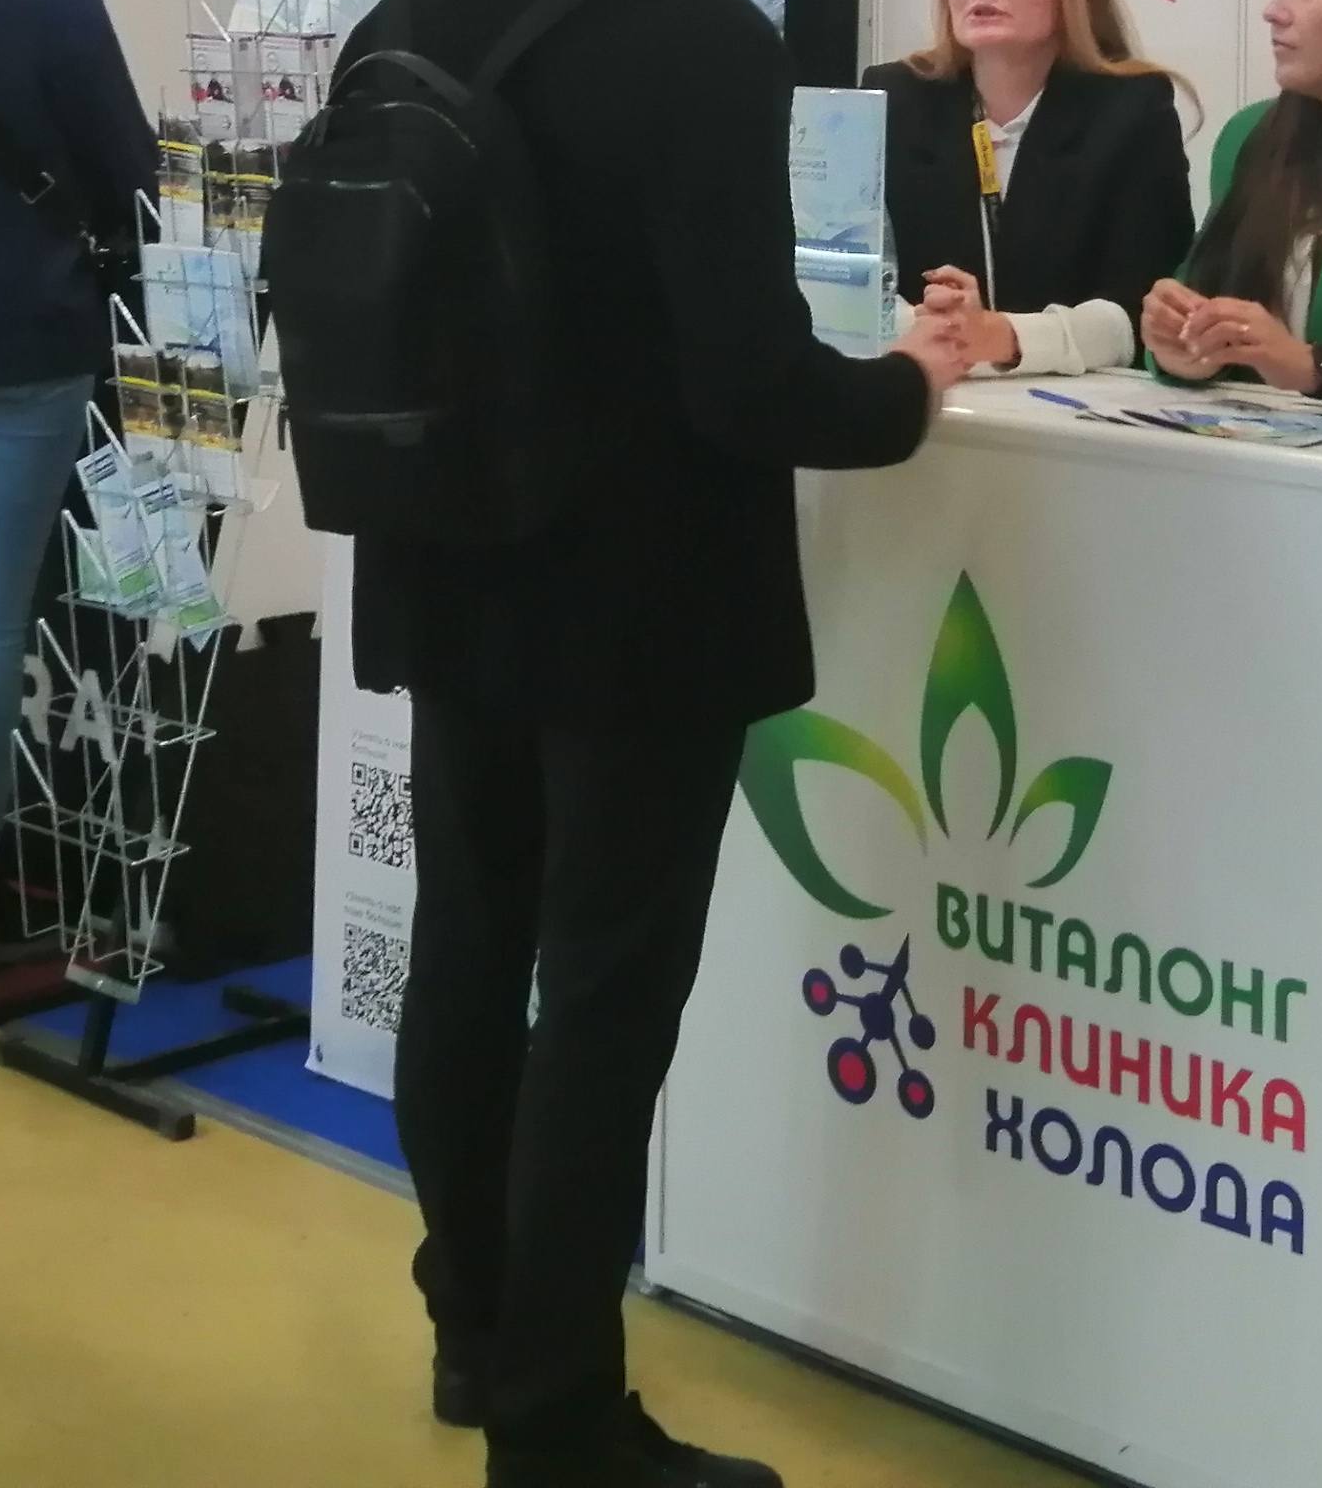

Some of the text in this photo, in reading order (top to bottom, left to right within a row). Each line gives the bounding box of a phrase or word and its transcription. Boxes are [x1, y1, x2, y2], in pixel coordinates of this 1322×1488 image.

[936, 882, 1308, 1044] ВИТАЛОНГ
[962, 986, 1307, 1153] КЛИНИКА
[984, 1087, 1305, 1256] ХОЛОДА
